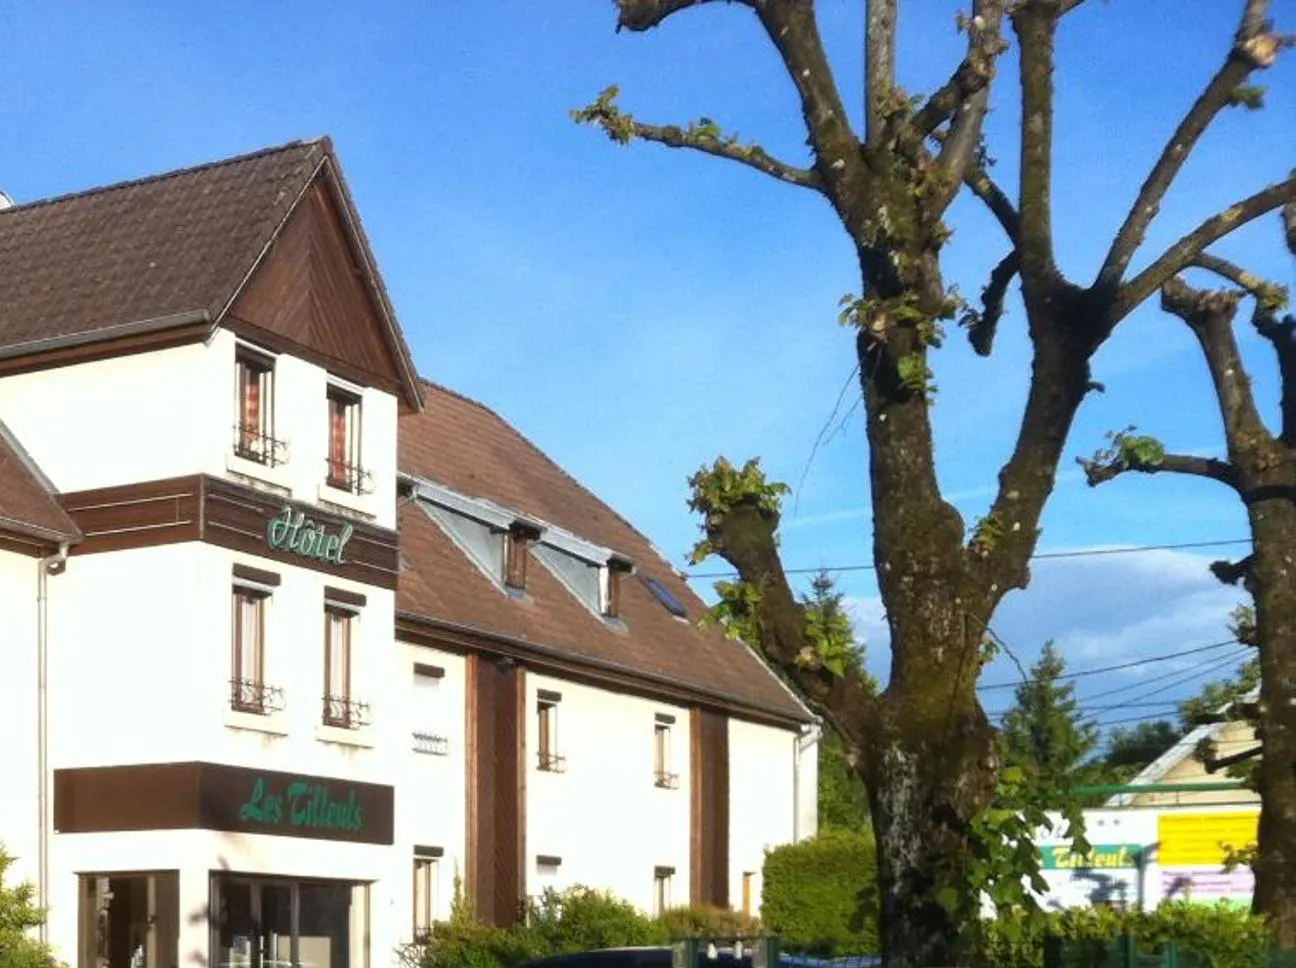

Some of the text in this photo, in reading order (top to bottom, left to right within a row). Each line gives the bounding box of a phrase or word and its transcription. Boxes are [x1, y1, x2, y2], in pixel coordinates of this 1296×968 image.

[268, 506, 354, 566] Hôtel
[239, 777, 364, 832] Les Tilleuls
